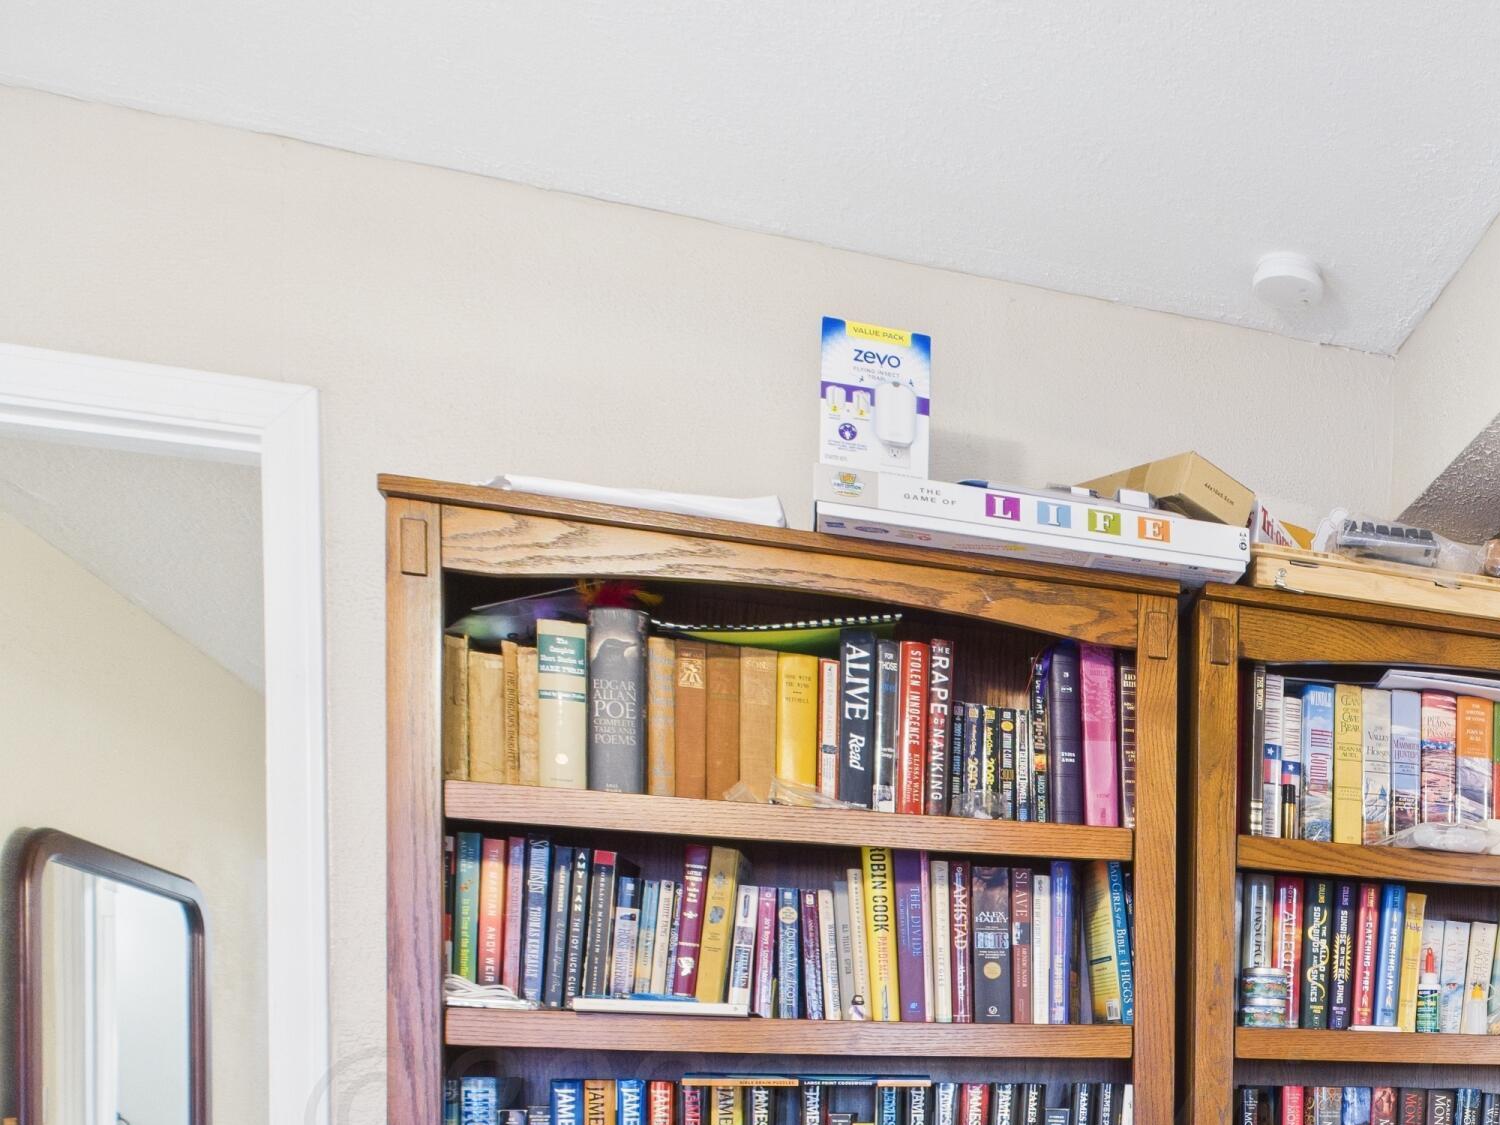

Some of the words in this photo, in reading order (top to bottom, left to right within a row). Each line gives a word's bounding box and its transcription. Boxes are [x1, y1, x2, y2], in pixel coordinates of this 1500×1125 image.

[853, 326, 880, 337] VALUE
[882, 332, 904, 341] PACK
[853, 366, 875, 375] FLYING
[877, 369, 900, 377] INSECT
[854, 349, 900, 368] zevo
[903, 492, 937, 505] GAME
[941, 497, 957, 506] OF
[919, 487, 941, 497] THE
[993, 496, 1164, 541] LIFE
[845, 642, 870, 720] ALIVE
[910, 650, 922, 686] STOLEN
[593, 678, 636, 691] EDGAR
[593, 690, 637, 701] ALLAN
[930, 656, 949, 715] RAPE
[593, 701, 637, 720] POE
[593, 718, 637, 728] COMPLETE
[908, 691, 921, 746] INNOCENCE
[594, 733, 637, 746] POEMS
[595, 726, 617, 735] TALES
[619, 727, 637, 735] AND
[1311, 729, 1332, 748] Hill
[848, 733, 865, 771] Read
[931, 729, 944, 800] NANKING
[1307, 753, 1330, 796] Country
[490, 849, 499, 866] THE
[576, 852, 585, 879] AMY
[869, 847, 887, 890] ROBIN
[1110, 862, 1121, 881] BAD
[487, 871, 498, 916] MARTIAN
[574, 884, 583, 912] TAN
[910, 888, 921, 909] THE
[1015, 872, 1027, 917] SLAVE
[1112, 882, 1122, 913] GIRLS
[529, 906, 542, 937] THOMAS
[572, 918, 580, 933] THE
[872, 895, 889, 932] COOK
[953, 883, 968, 949] AMISTAD
[1339, 910, 1348, 944] SUNRISE
[486, 926, 497, 953] ANDY
[570, 935, 579, 950] JOY
[911, 915, 922, 957] DIVIDE
[1117, 929, 1127, 955] BIBLE
[1312, 906, 1321, 953] SONGBIRDS
[1363, 922, 1372, 966] CATCHING
[485, 957, 496, 982] WEIR
[525, 938, 540, 978] KENEALLY
[568, 953, 578, 973] LUCK
[877, 936, 888, 981] PANDEMIC
[1319, 938, 1327, 972] BALLAD
[1386, 927, 1397, 991] MOCKINGJAY
[567, 976, 577, 997] CLUB
[1122, 970, 1133, 1004] HIGGS
[1310, 970, 1318, 1002] SNAKES
[1337, 968, 1345, 1004] REAPING
[1362, 971, 1371, 992] FIRE
